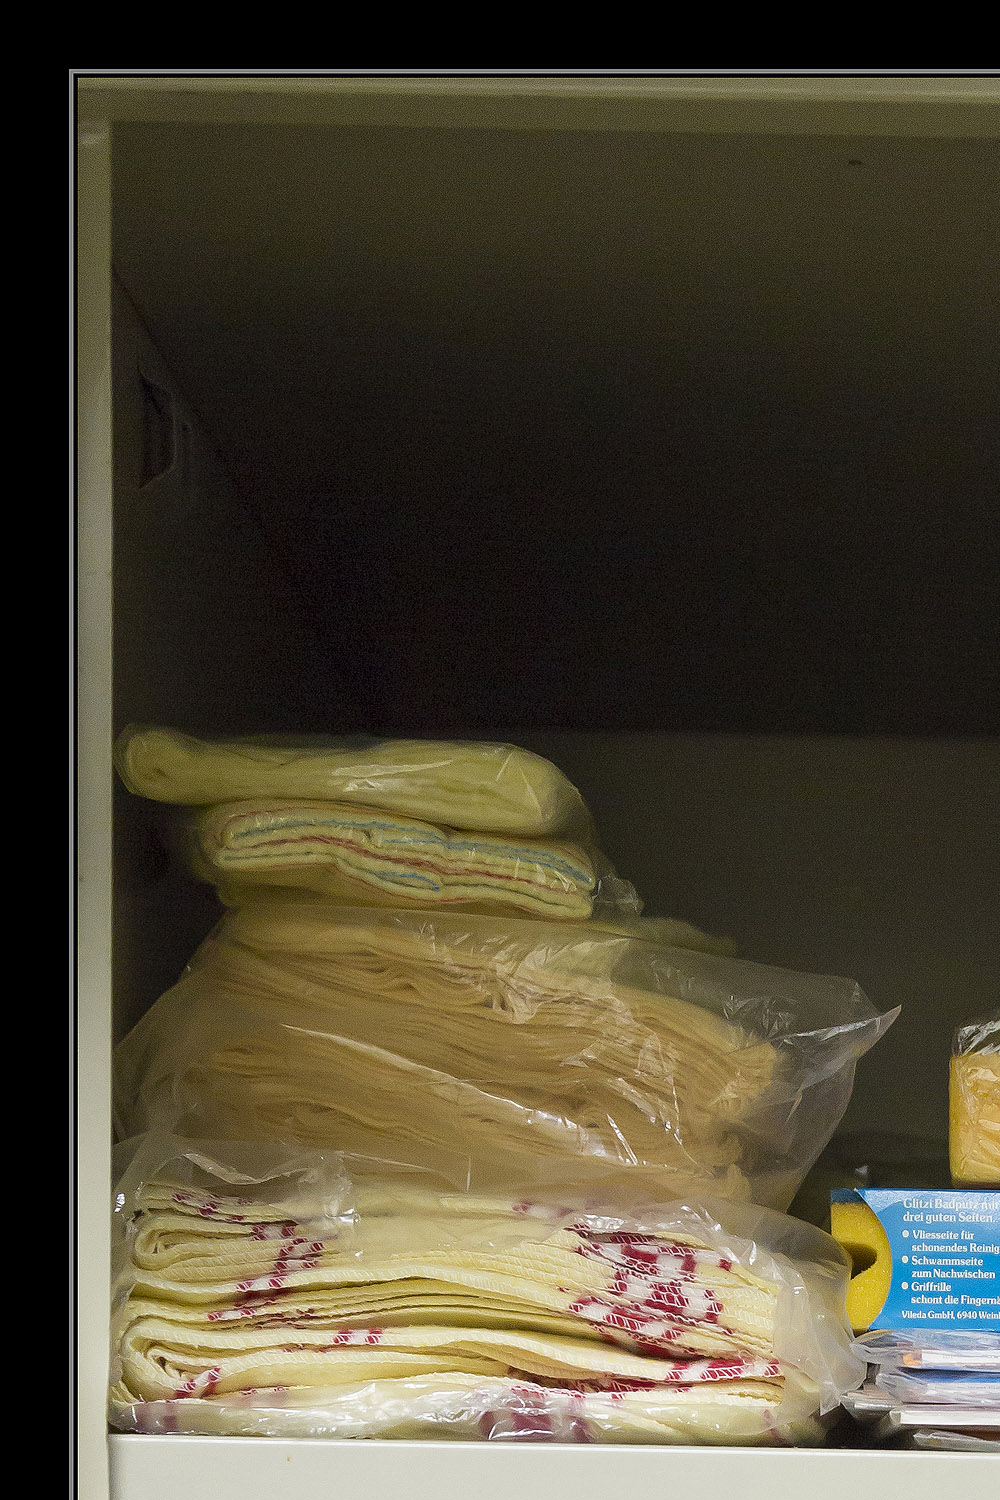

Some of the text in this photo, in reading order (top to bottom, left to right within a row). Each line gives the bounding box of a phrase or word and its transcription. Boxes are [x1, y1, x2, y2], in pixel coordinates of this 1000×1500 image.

[903, 1198, 932, 1209] Glitzi
[981, 1199, 1000, 1210] mit
[903, 1211, 923, 1222] drei
[926, 1212, 956, 1224] guten
[912, 1230, 975, 1240] Vliesseite für
[912, 1243, 967, 1253] schonendes
[911, 1256, 984, 1266] Schwammseite
[911, 1268, 996, 1279] zum Nachwischen
[911, 1281, 952, 1292] Griffrille
[911, 1294, 942, 1305] schont
[944, 1295, 959, 1305] die
[901, 1310, 926, 1319] Vileda
[957, 1311, 978, 1320] 6940
